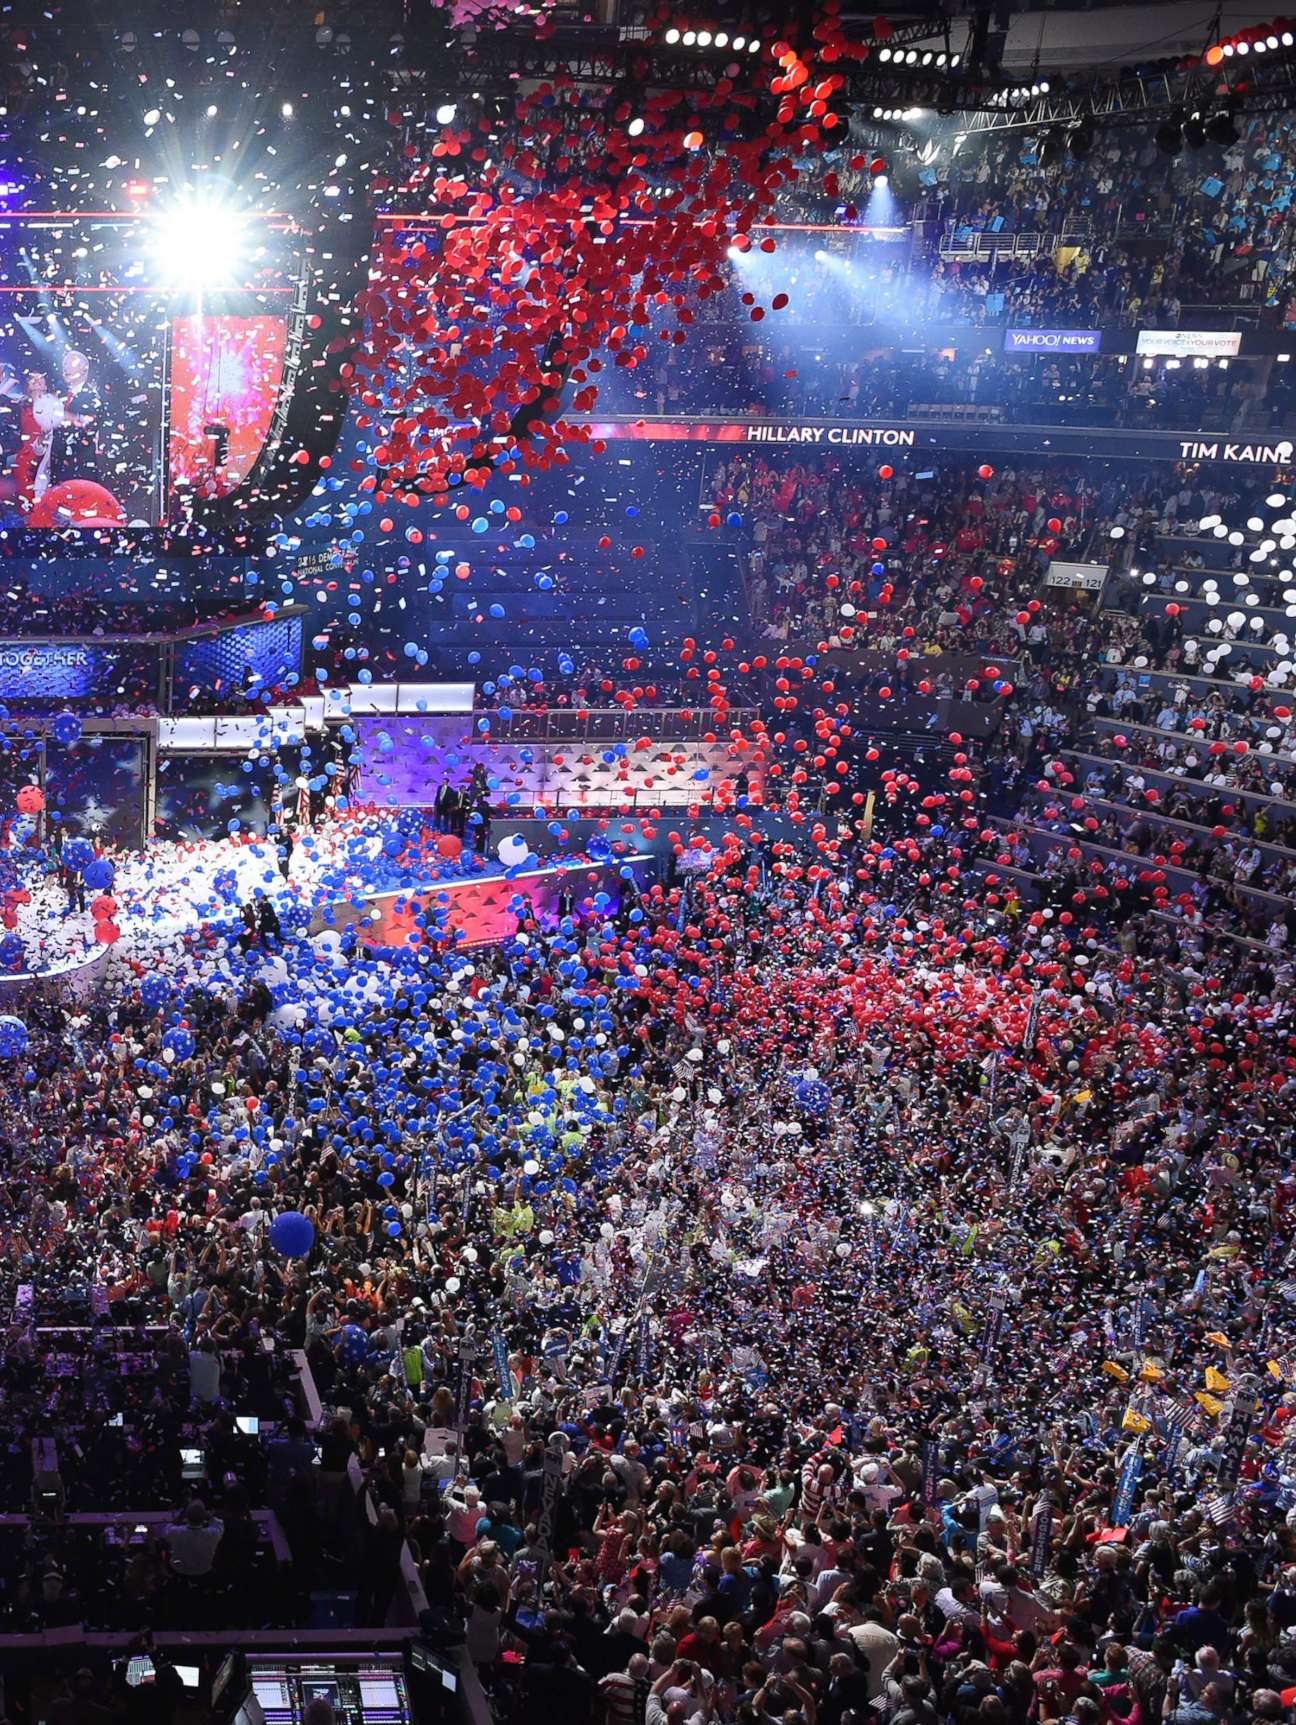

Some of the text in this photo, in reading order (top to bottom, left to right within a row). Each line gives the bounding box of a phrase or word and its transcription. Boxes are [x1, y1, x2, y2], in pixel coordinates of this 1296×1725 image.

[1012, 334, 1095, 346] YAHOO! NEWS
[747, 426, 915, 445] HILLARY CLINTON
[1179, 442, 1218, 459] TIM
[1051, 576, 1071, 586] 122
[1086, 579, 1102, 588] 121
[640, 1315, 649, 1368] HILLARY
[1225, 1411, 1248, 1480] HAWAII
[536, 1472, 558, 1553] NEVADA
